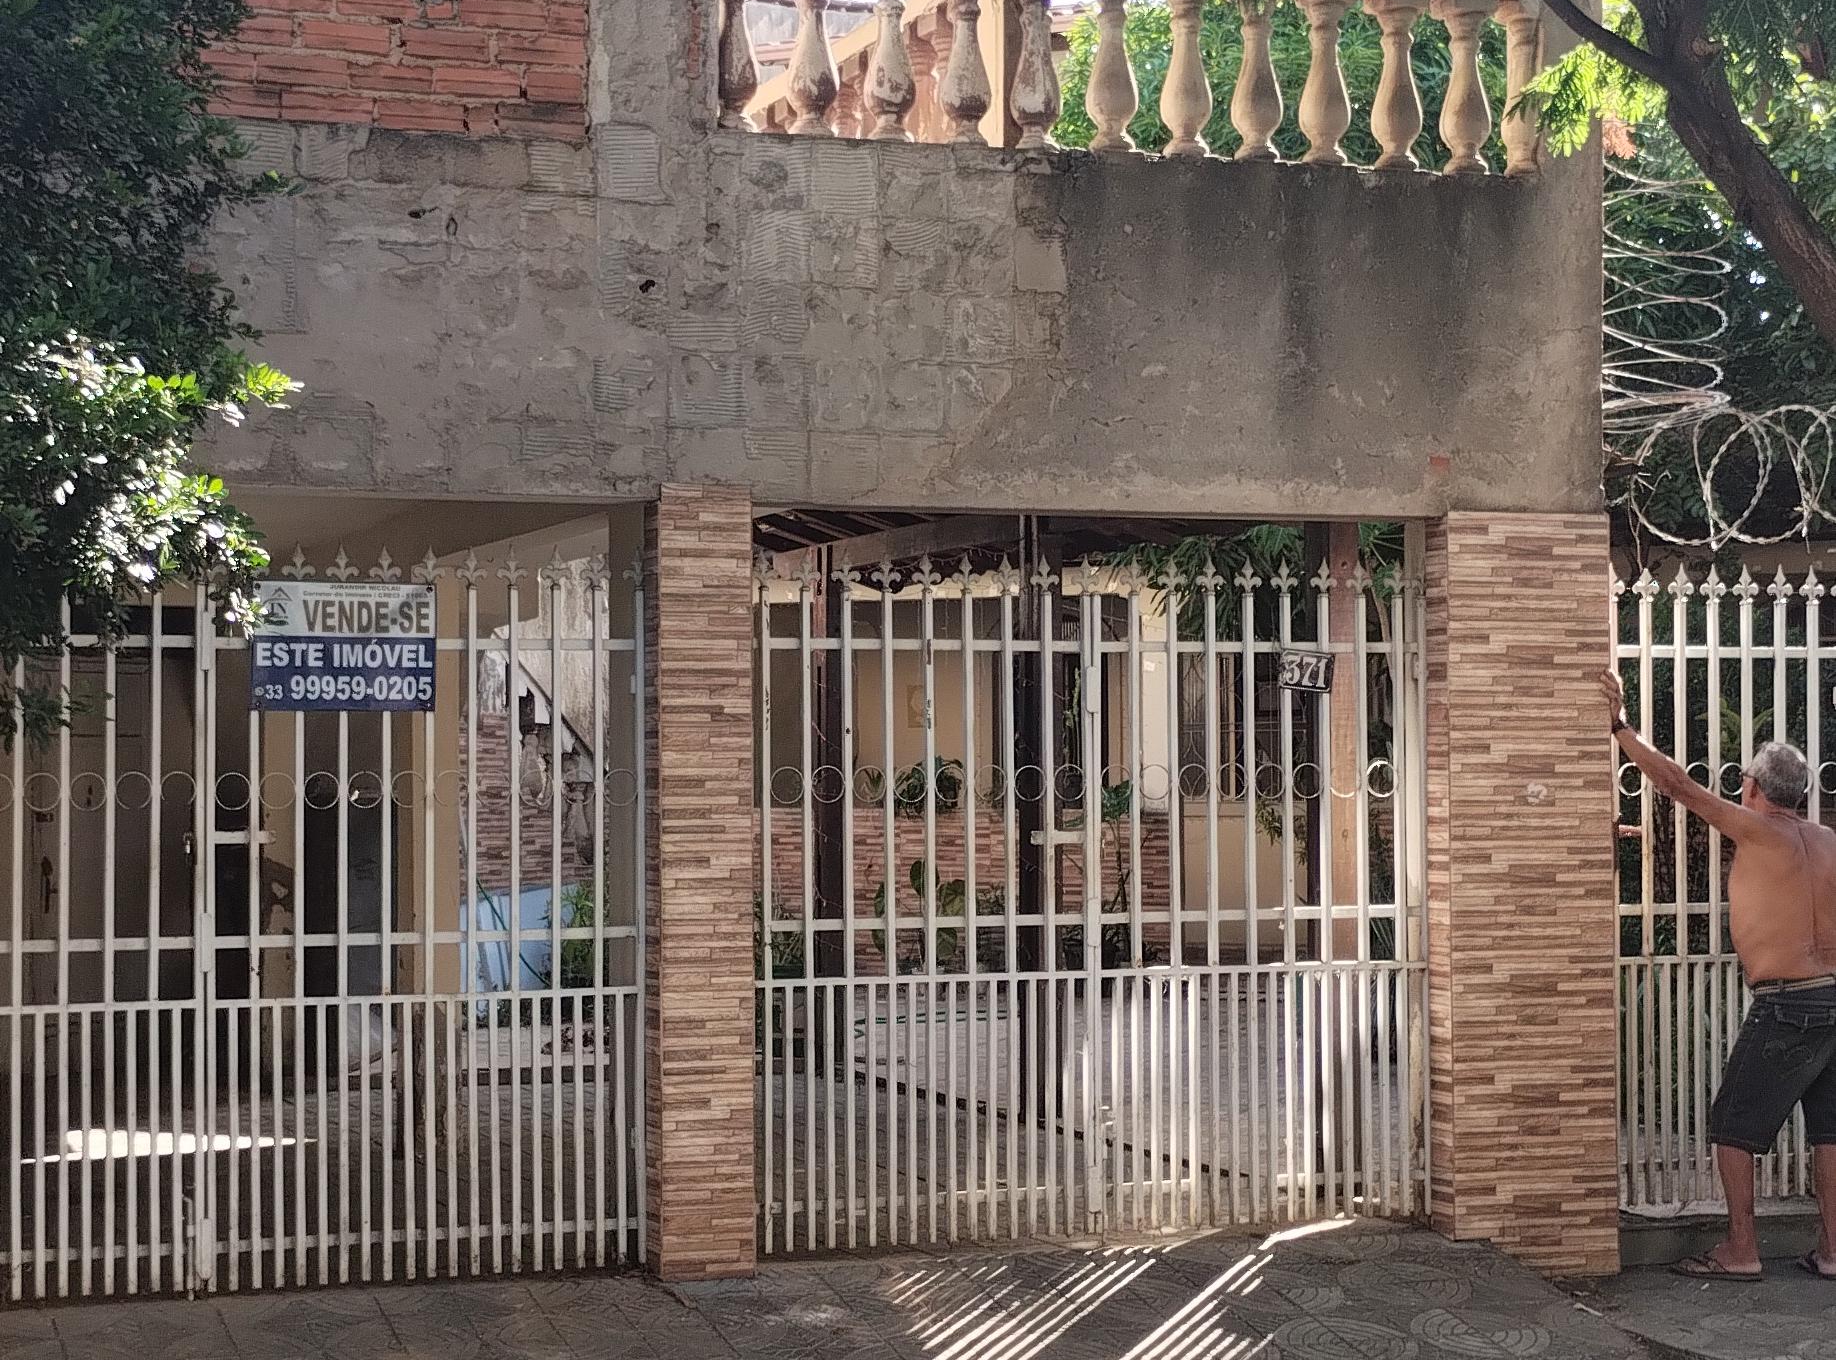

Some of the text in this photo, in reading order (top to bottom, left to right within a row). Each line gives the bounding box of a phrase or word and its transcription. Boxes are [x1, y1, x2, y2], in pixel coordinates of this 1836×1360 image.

[303, 600, 430, 634] VENDE-SE
[256, 639, 433, 668] ESTE IMÓVEL
[1283, 655, 1329, 688] 371
[265, 675, 433, 701] 33 99959-0205
